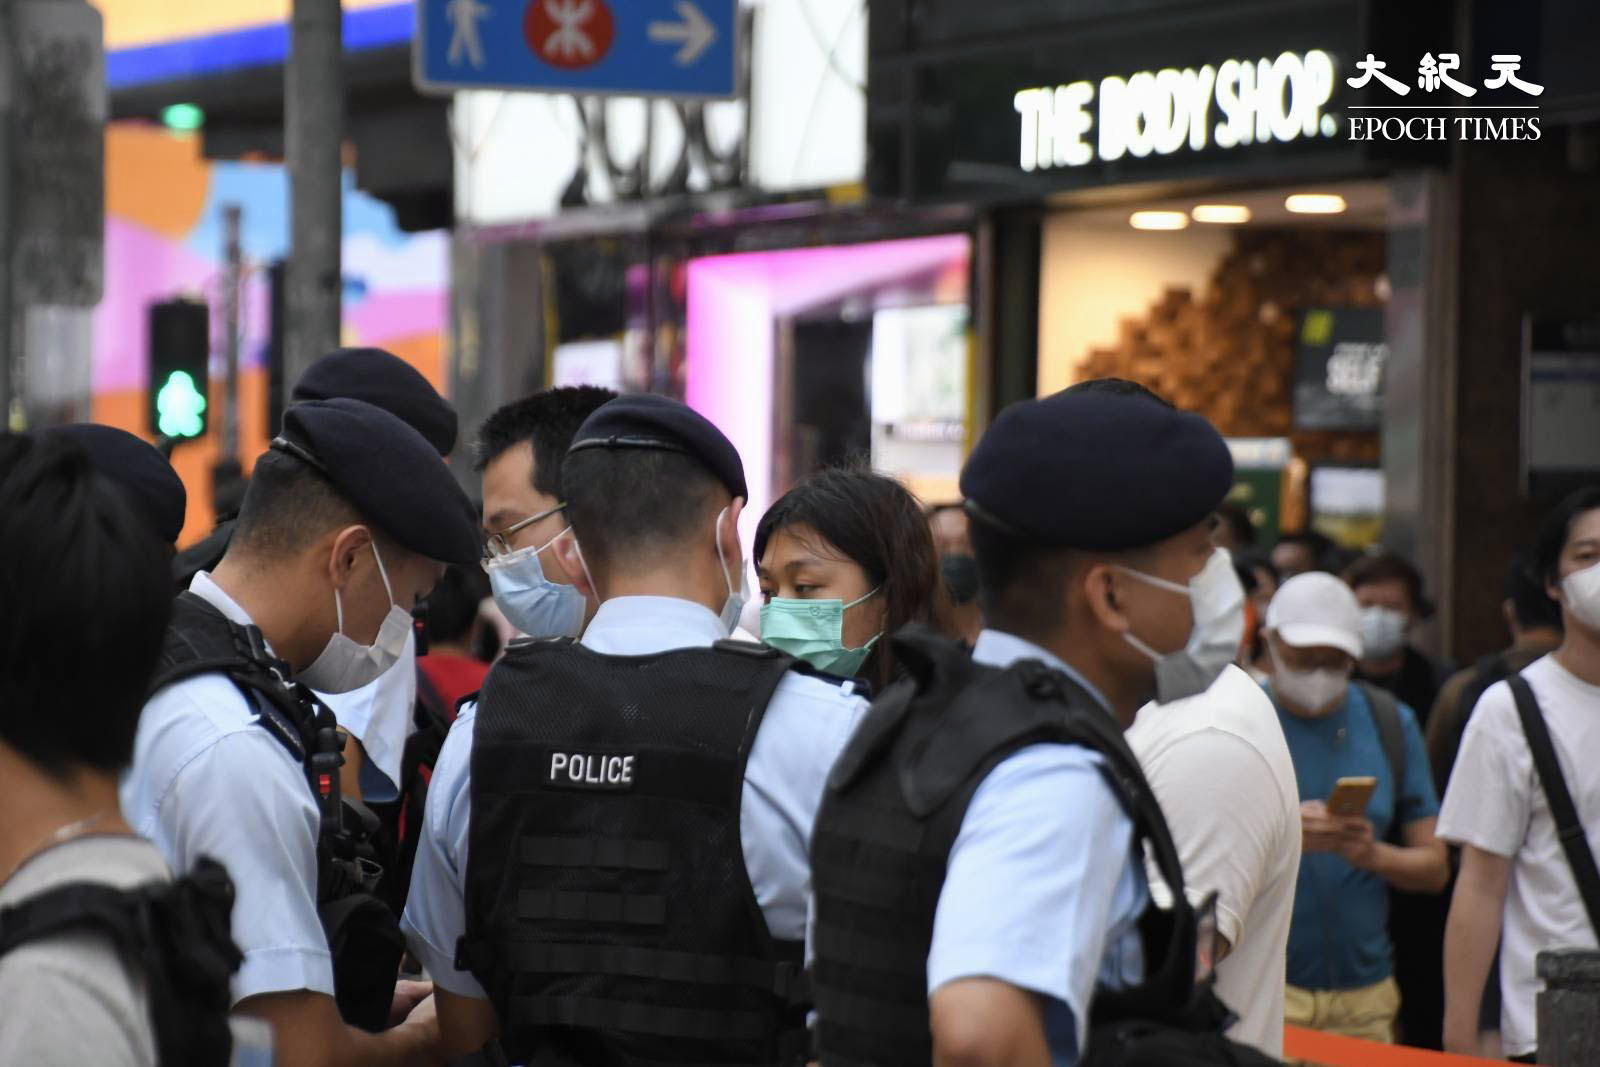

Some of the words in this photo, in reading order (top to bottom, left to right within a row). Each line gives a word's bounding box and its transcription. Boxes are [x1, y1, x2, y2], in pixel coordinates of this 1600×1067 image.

[1014, 82, 1093, 172] THE
[1099, 64, 1216, 162] BODY
[550, 752, 634, 783] POLICE
